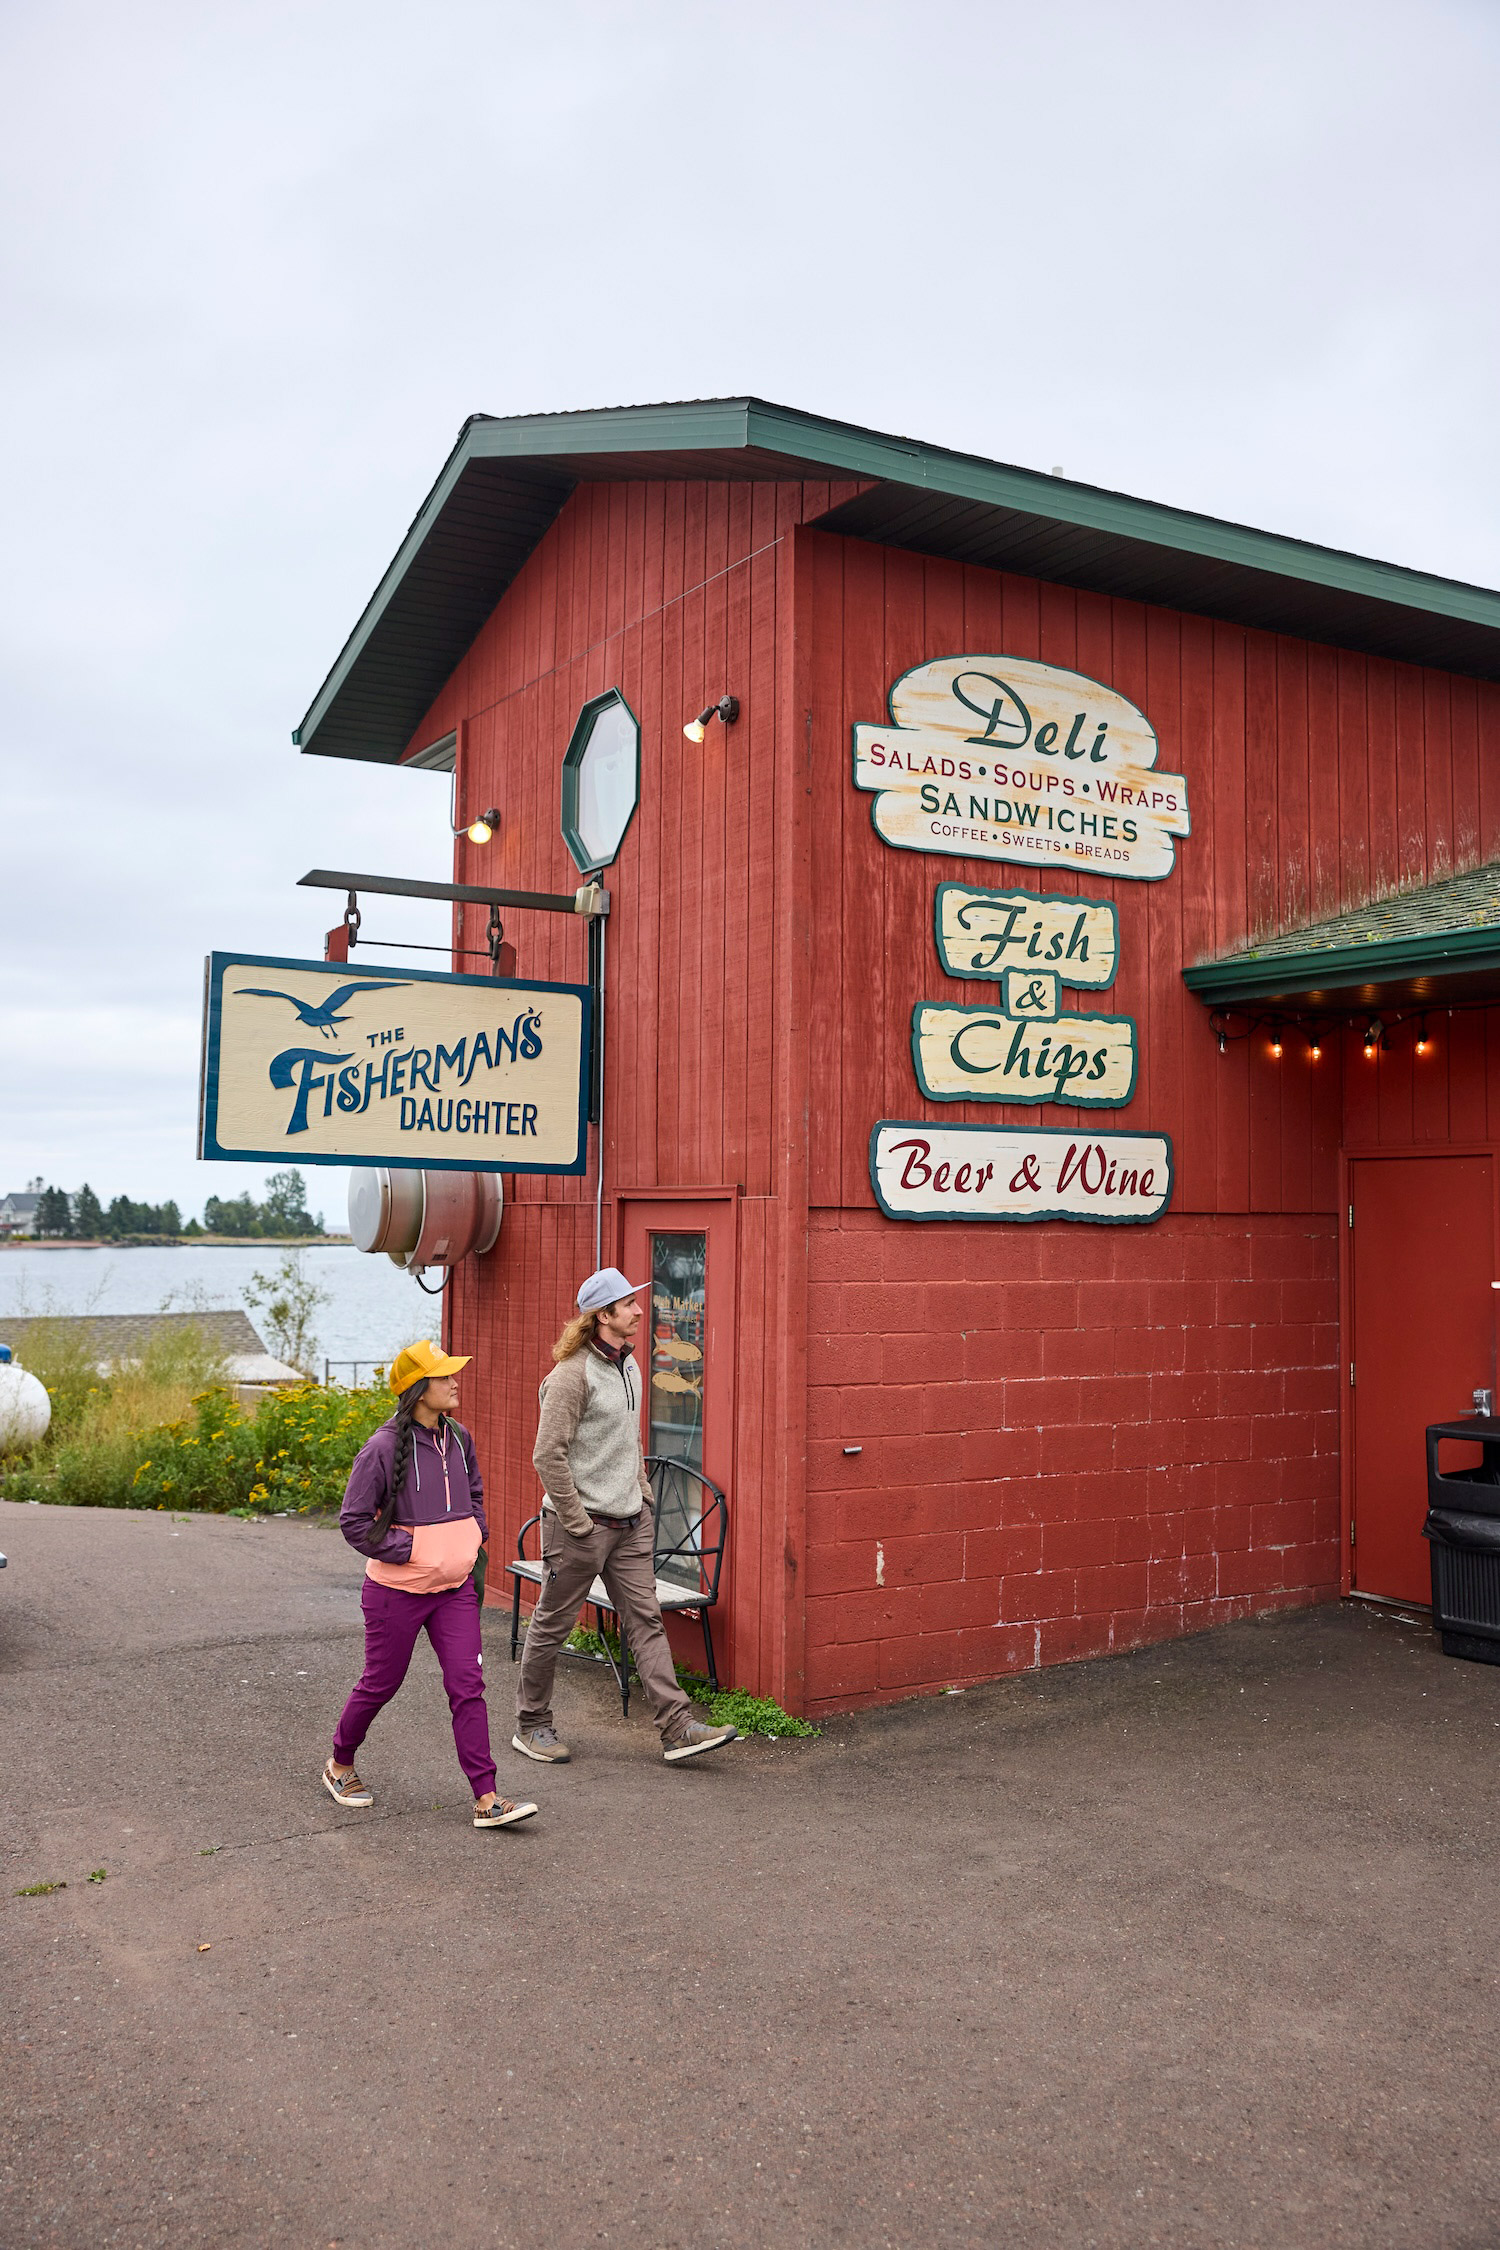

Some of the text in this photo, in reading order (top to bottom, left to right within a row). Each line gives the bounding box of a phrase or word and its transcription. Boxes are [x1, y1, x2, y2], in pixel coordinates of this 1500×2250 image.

[952, 671, 1108, 763] Deli
[870, 743, 1178, 812] SALADS SOUPS WRAPS
[920, 783, 1138, 843] SANDWICHES
[930, 821, 1130, 862] COFFEE SWEETS BREADS
[957, 900, 1089, 968] Fish
[1015, 980, 1048, 1011] &
[366, 1027, 404, 1048] THE
[950, 1019, 1107, 1100] Chips
[400, 1096, 538, 1136] DAUGHTER
[888, 1138, 1156, 1197] Beer & Wine
[673, 1296, 703, 1312] Market
